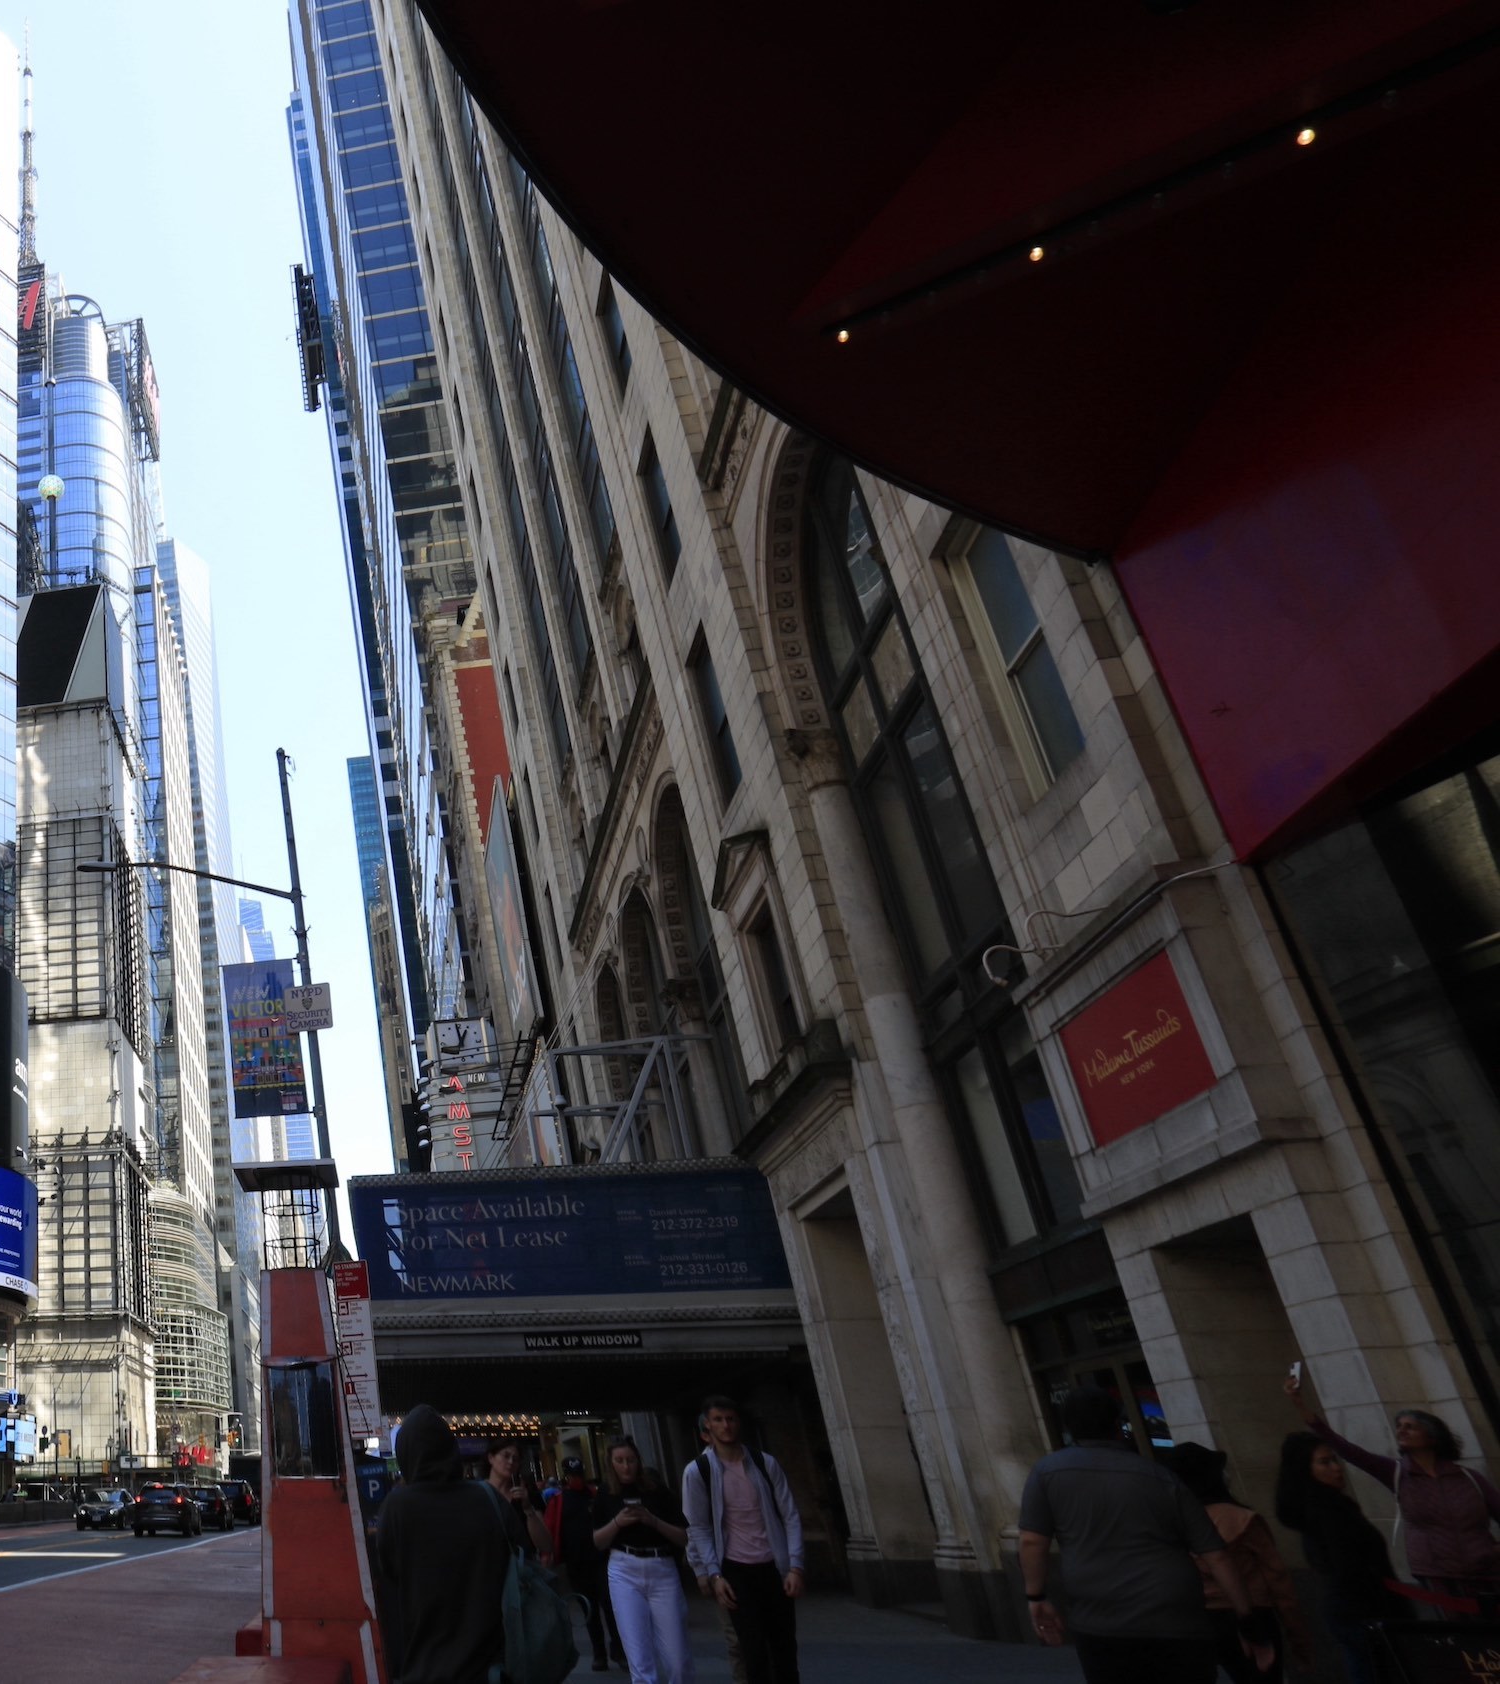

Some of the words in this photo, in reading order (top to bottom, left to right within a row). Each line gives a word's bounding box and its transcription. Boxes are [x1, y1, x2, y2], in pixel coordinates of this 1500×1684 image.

[291, 987, 323, 999] NYPD
[230, 999, 285, 1018] VICTOR
[1082, 1048, 1134, 1089] Madame
[1122, 1009, 1182, 1058] Tussauds
[467, 1073, 486, 1083] NEW
[1120, 1073, 1134, 1086] NEW
[1136, 1060, 1156, 1075] YORK
[9, 1207, 22, 1219] world
[398, 1199, 464, 1229] Space
[472, 1195, 586, 1220] Available
[651, 1215, 739, 1231] 212-372-2319
[399, 1228, 438, 1251] For
[445, 1227, 489, 1250] Net
[499, 1225, 568, 1249] Lease
[660, 1261, 748, 1276] 212-331-0126
[5, 1276, 24, 1290] CHASE
[401, 1273, 516, 1294] NEWMARK
[525, 1336, 560, 1348] WALK
[563, 1335, 580, 1348] UP
[582, 1333, 634, 1347] WINDOW
[368, 1479, 380, 1499] P
